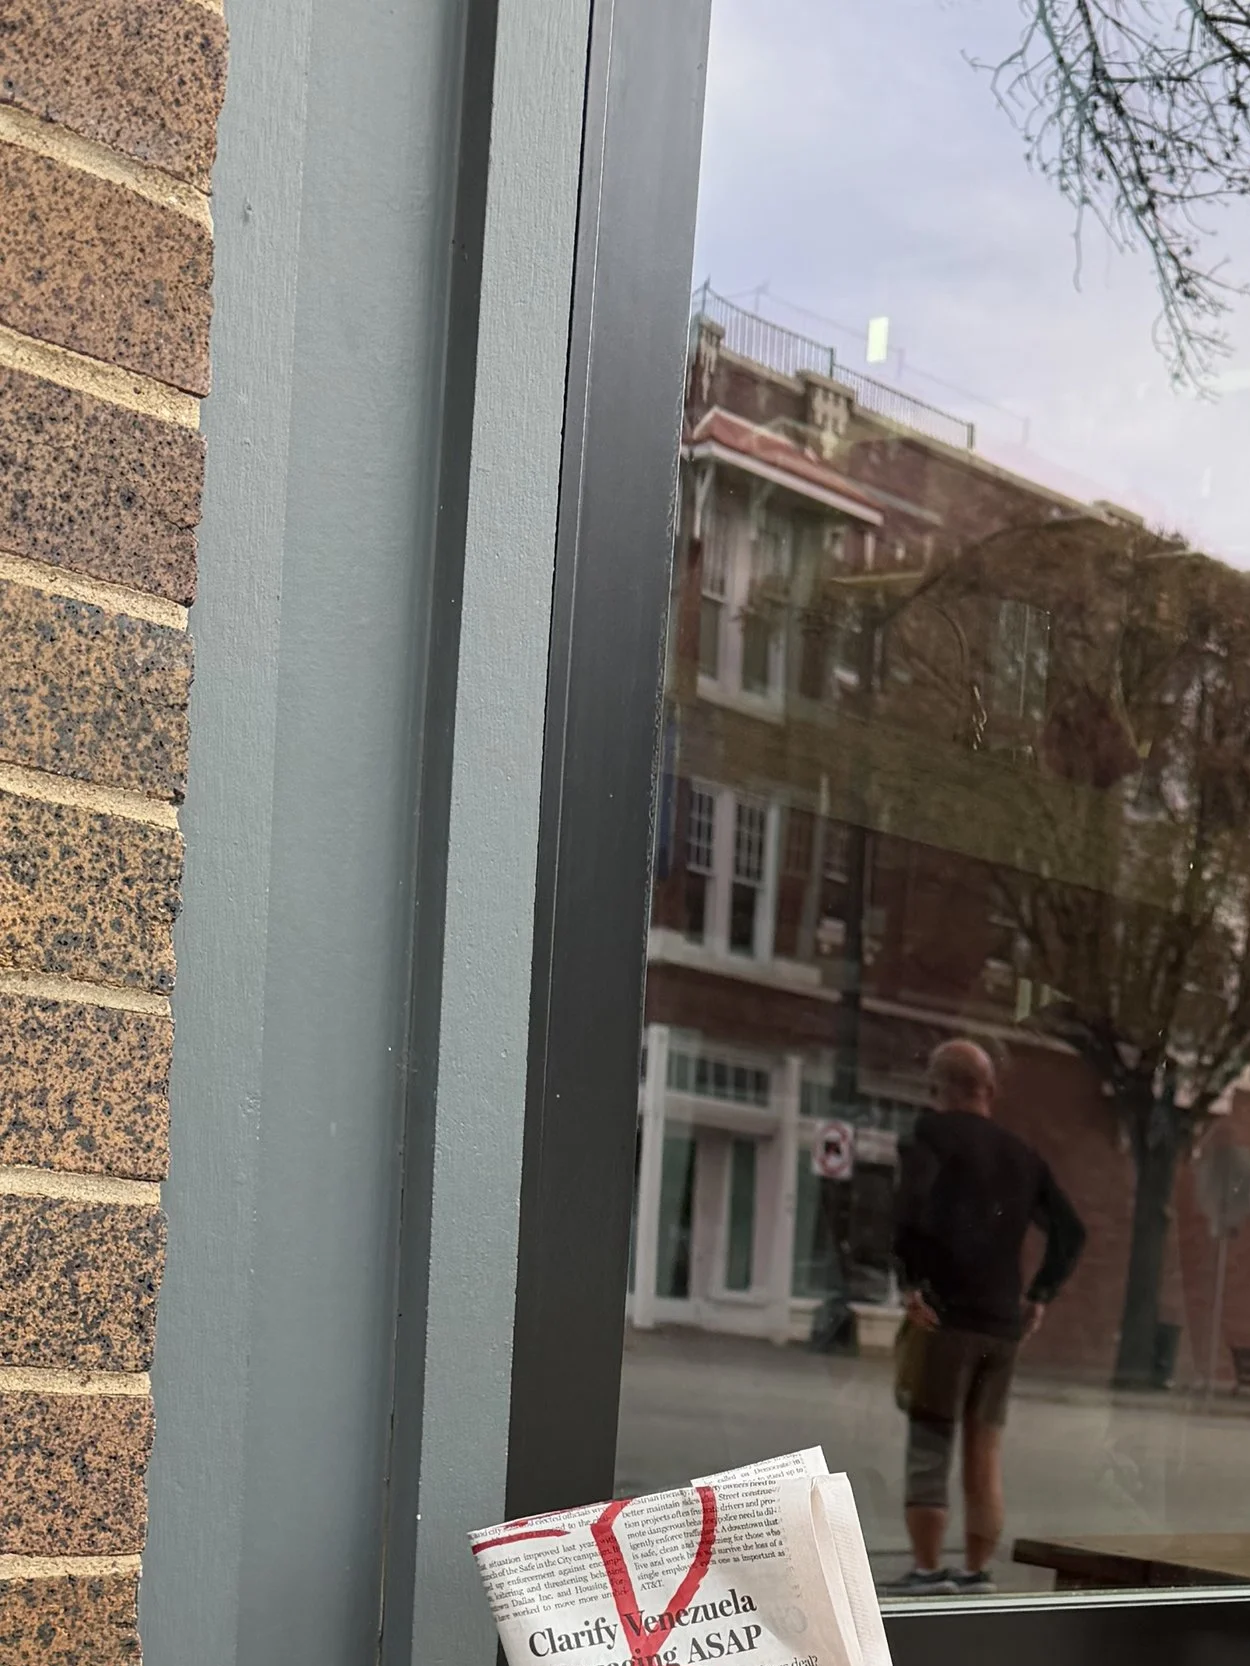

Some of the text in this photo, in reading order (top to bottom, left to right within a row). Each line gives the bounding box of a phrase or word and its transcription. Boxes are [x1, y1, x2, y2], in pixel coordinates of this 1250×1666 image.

[622, 1509, 644, 1518] better
[646, 1501, 680, 1513] maintain
[718, 1492, 739, 1500] Street
[624, 1498, 776, 1529] tion projects often drivers and pro-
[627, 1530, 646, 1539] mote
[647, 1522, 686, 1535] dangerous
[719, 1513, 737, 1524] police
[738, 1510, 756, 1520] need
[629, 1538, 654, 1551] igently
[655, 1534, 682, 1544] enforce
[721, 1525, 727, 1533] A
[727, 1522, 764, 1532] downtown
[764, 1518, 779, 1527] that
[523, 1546, 560, 1561] improved
[562, 1544, 576, 1552] last
[634, 1562, 648, 1571] live
[650, 1557, 665, 1567] and
[666, 1553, 686, 1564] work
[718, 1546, 741, 1554] survive
[742, 1543, 753, 1551] the
[754, 1541, 768, 1549] loss
[769, 1539, 777, 1547] of
[640, 1549, 658, 1558] safe,
[659, 1545, 679, 1554] clean
[681, 1540, 695, 1549] and
[745, 1532, 764, 1540] those
[507, 1571, 555, 1585] enforcement
[558, 1564, 586, 1576] against
[518, 1563, 535, 1573] Safe
[544, 1559, 556, 1567] the
[557, 1557, 572, 1565] City
[637, 1570, 659, 1580] single
[741, 1551, 776, 1562] important
[511, 1597, 535, 1607] Dallas
[557, 1588, 572, 1598] and
[575, 1582, 608, 1594] Housing
[527, 1583, 542, 1593] and
[544, 1576, 589, 1589] threatening
[554, 1600, 575, 1609] move
[578, 1595, 598, 1604] more
[529, 1589, 758, 1658] Clarify Venezuela
[687, 1624, 762, 1666] ASAP
